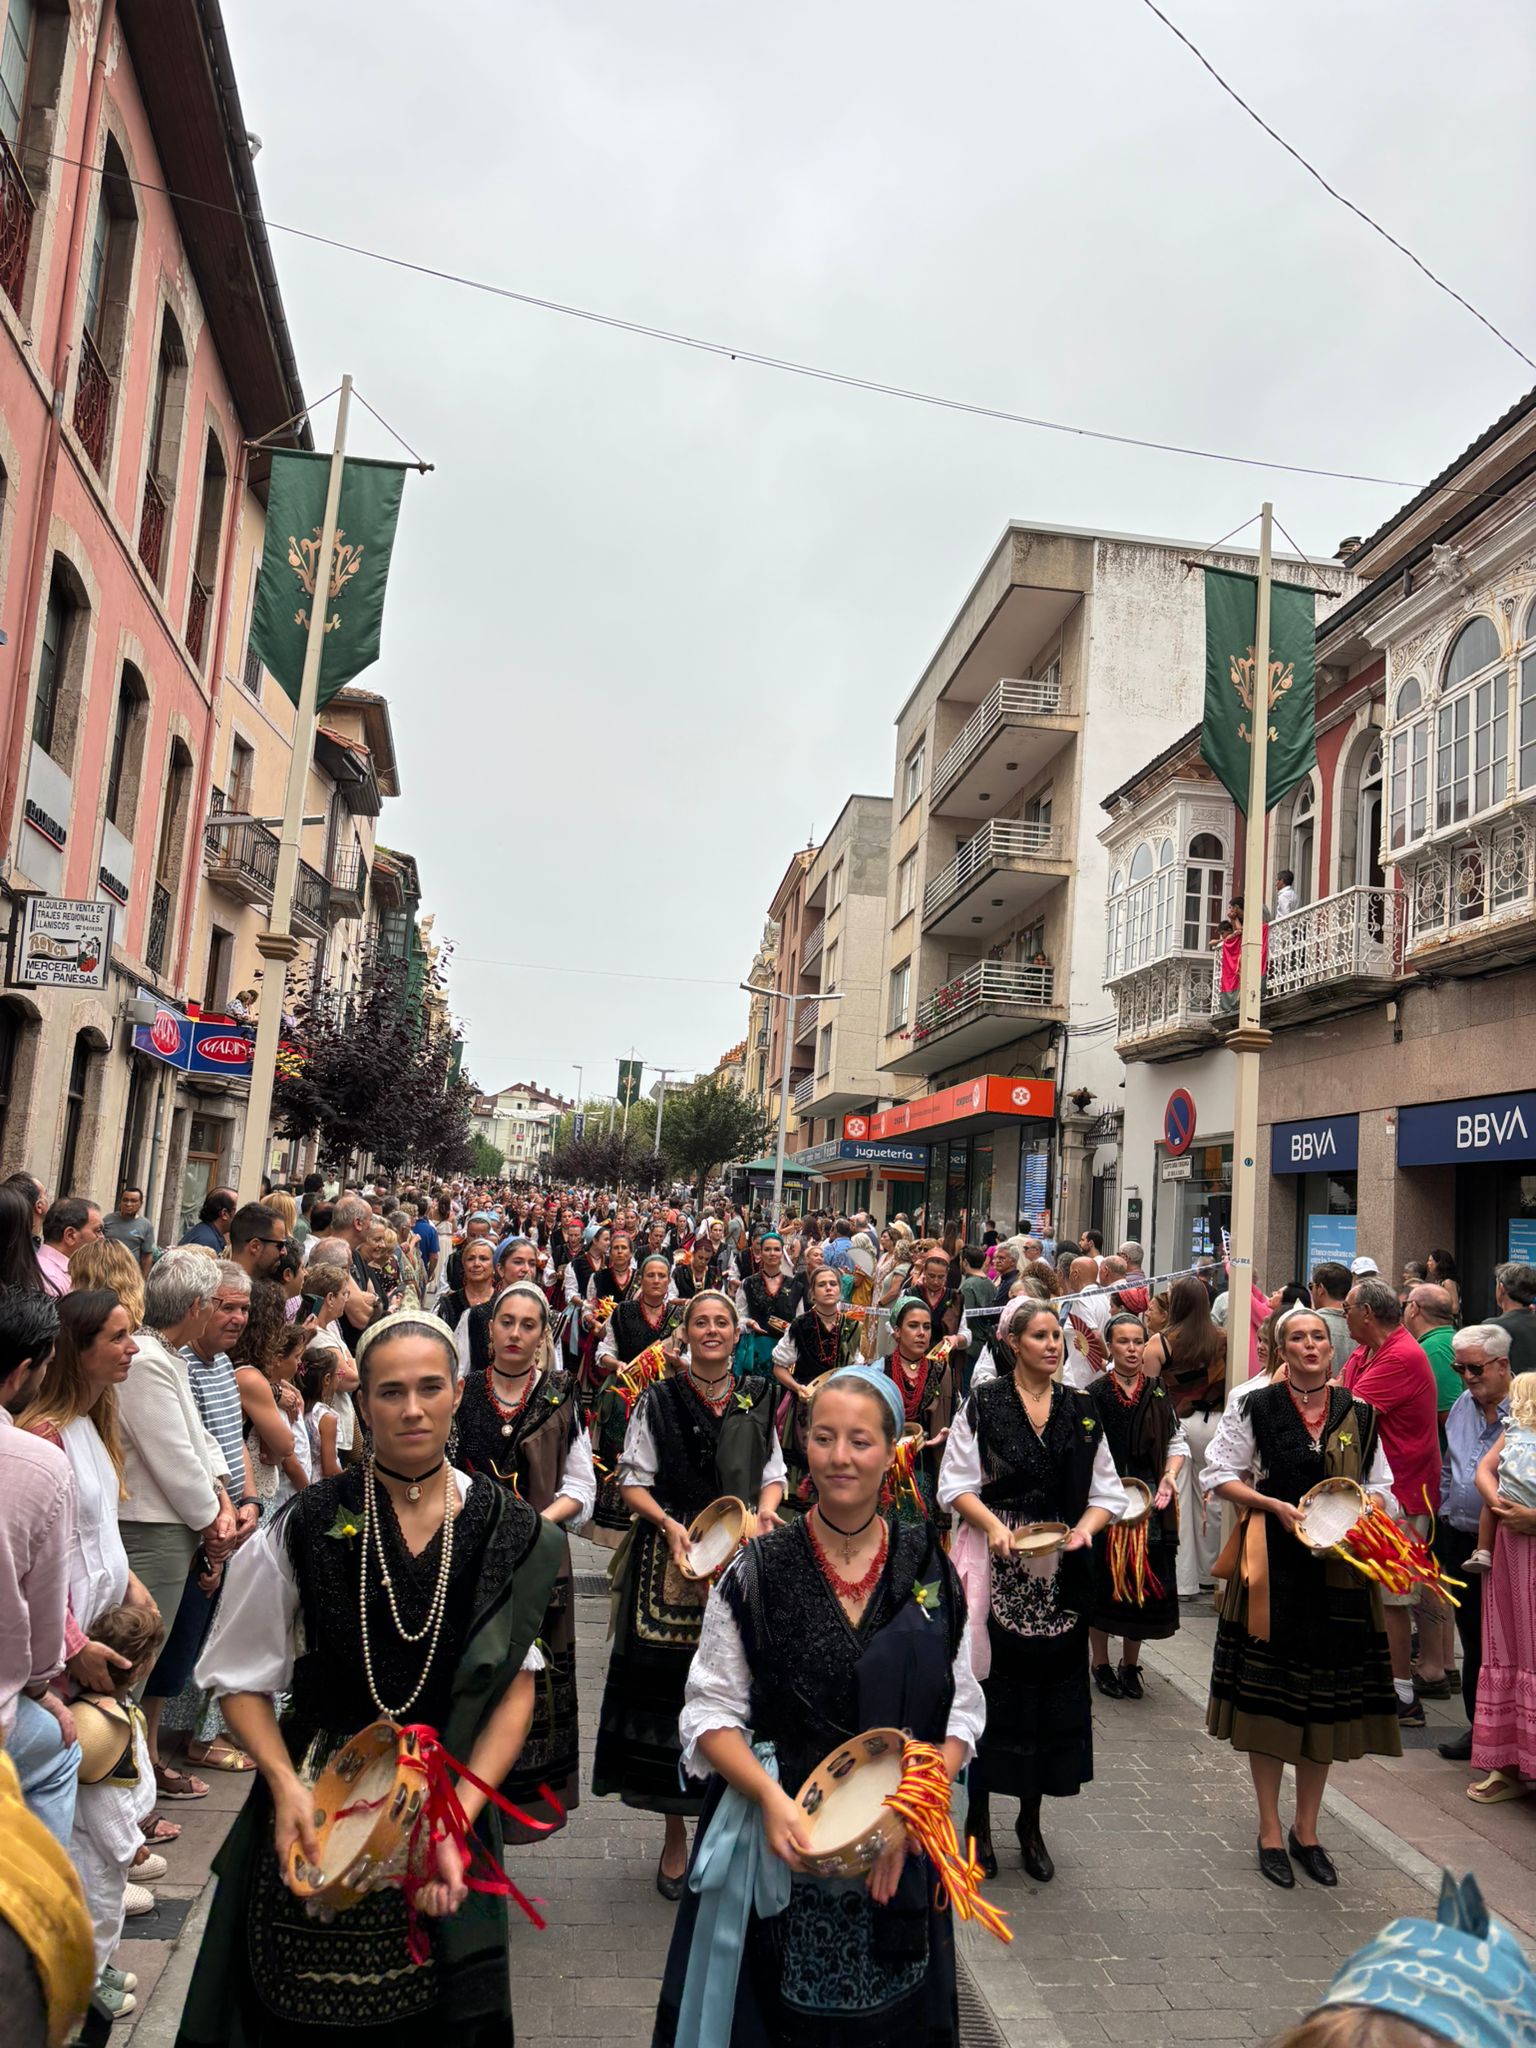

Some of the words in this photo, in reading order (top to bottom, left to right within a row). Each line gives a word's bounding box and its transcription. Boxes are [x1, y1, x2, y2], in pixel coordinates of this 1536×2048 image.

[37, 900, 67, 911] ALQUILER
[68, 902, 74, 911] Y
[75, 903, 95, 913] VENTA
[96, 905, 106, 914] DE
[37, 910, 61, 920] TRAJES
[62, 912, 100, 924] REGIONALES
[35, 920, 70, 931] LLANISCOS
[26, 960, 78, 974] MERCERIA
[29, 971, 49, 981] LAS
[52, 972, 99, 985] PANESAS
[1457, 1105, 1529, 1149] BBVA
[1291, 1127, 1337, 1162] BBVA
[854, 1144, 914, 1160] juguetería
